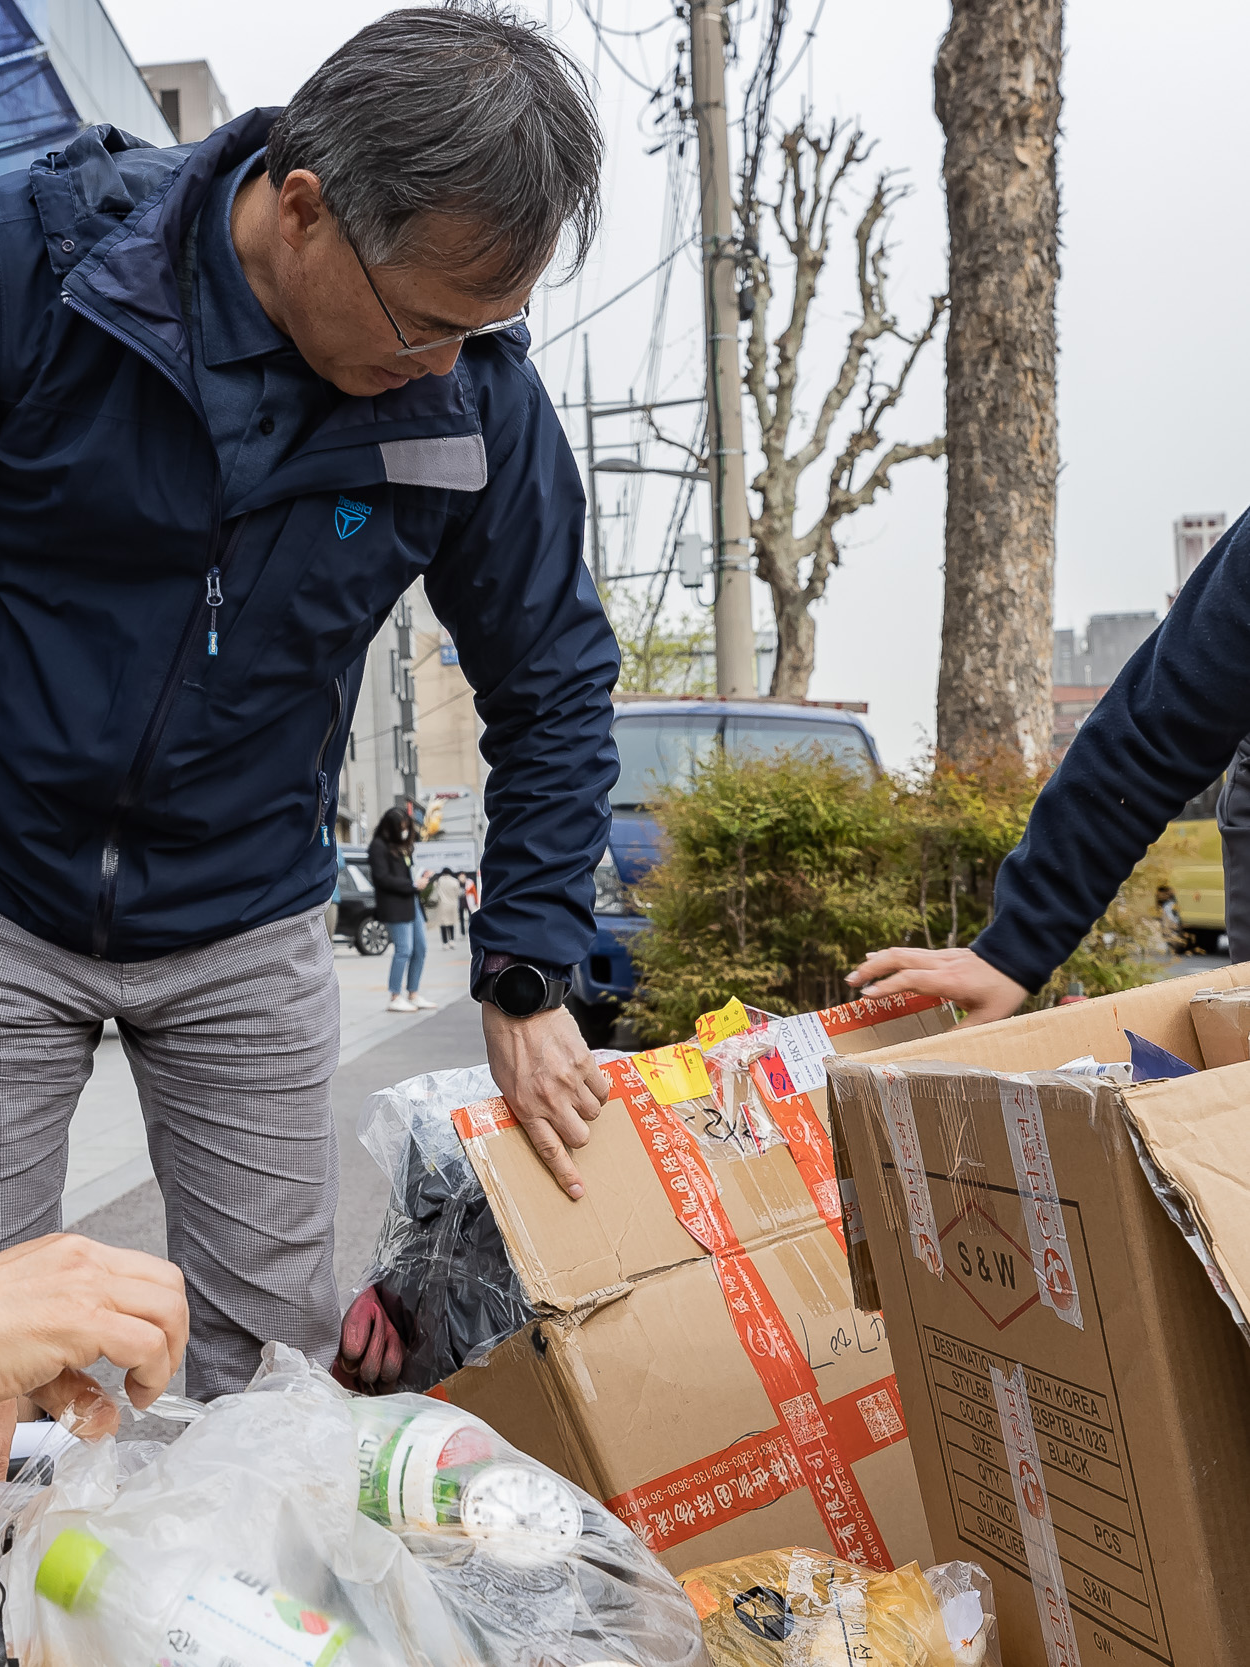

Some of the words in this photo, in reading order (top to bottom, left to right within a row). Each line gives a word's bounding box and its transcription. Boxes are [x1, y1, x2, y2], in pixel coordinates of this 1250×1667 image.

[951, 1370, 993, 1403] STYLE#:
[1053, 1383, 1101, 1420] KOREA
[959, 1400, 998, 1433] COLOR:
[1048, 1441, 1091, 1478] BLACK
[971, 1433, 997, 1461] SIZE:
[1093, 1523, 1122, 1554] PCS
[1082, 1576, 1113, 1612] S&W
